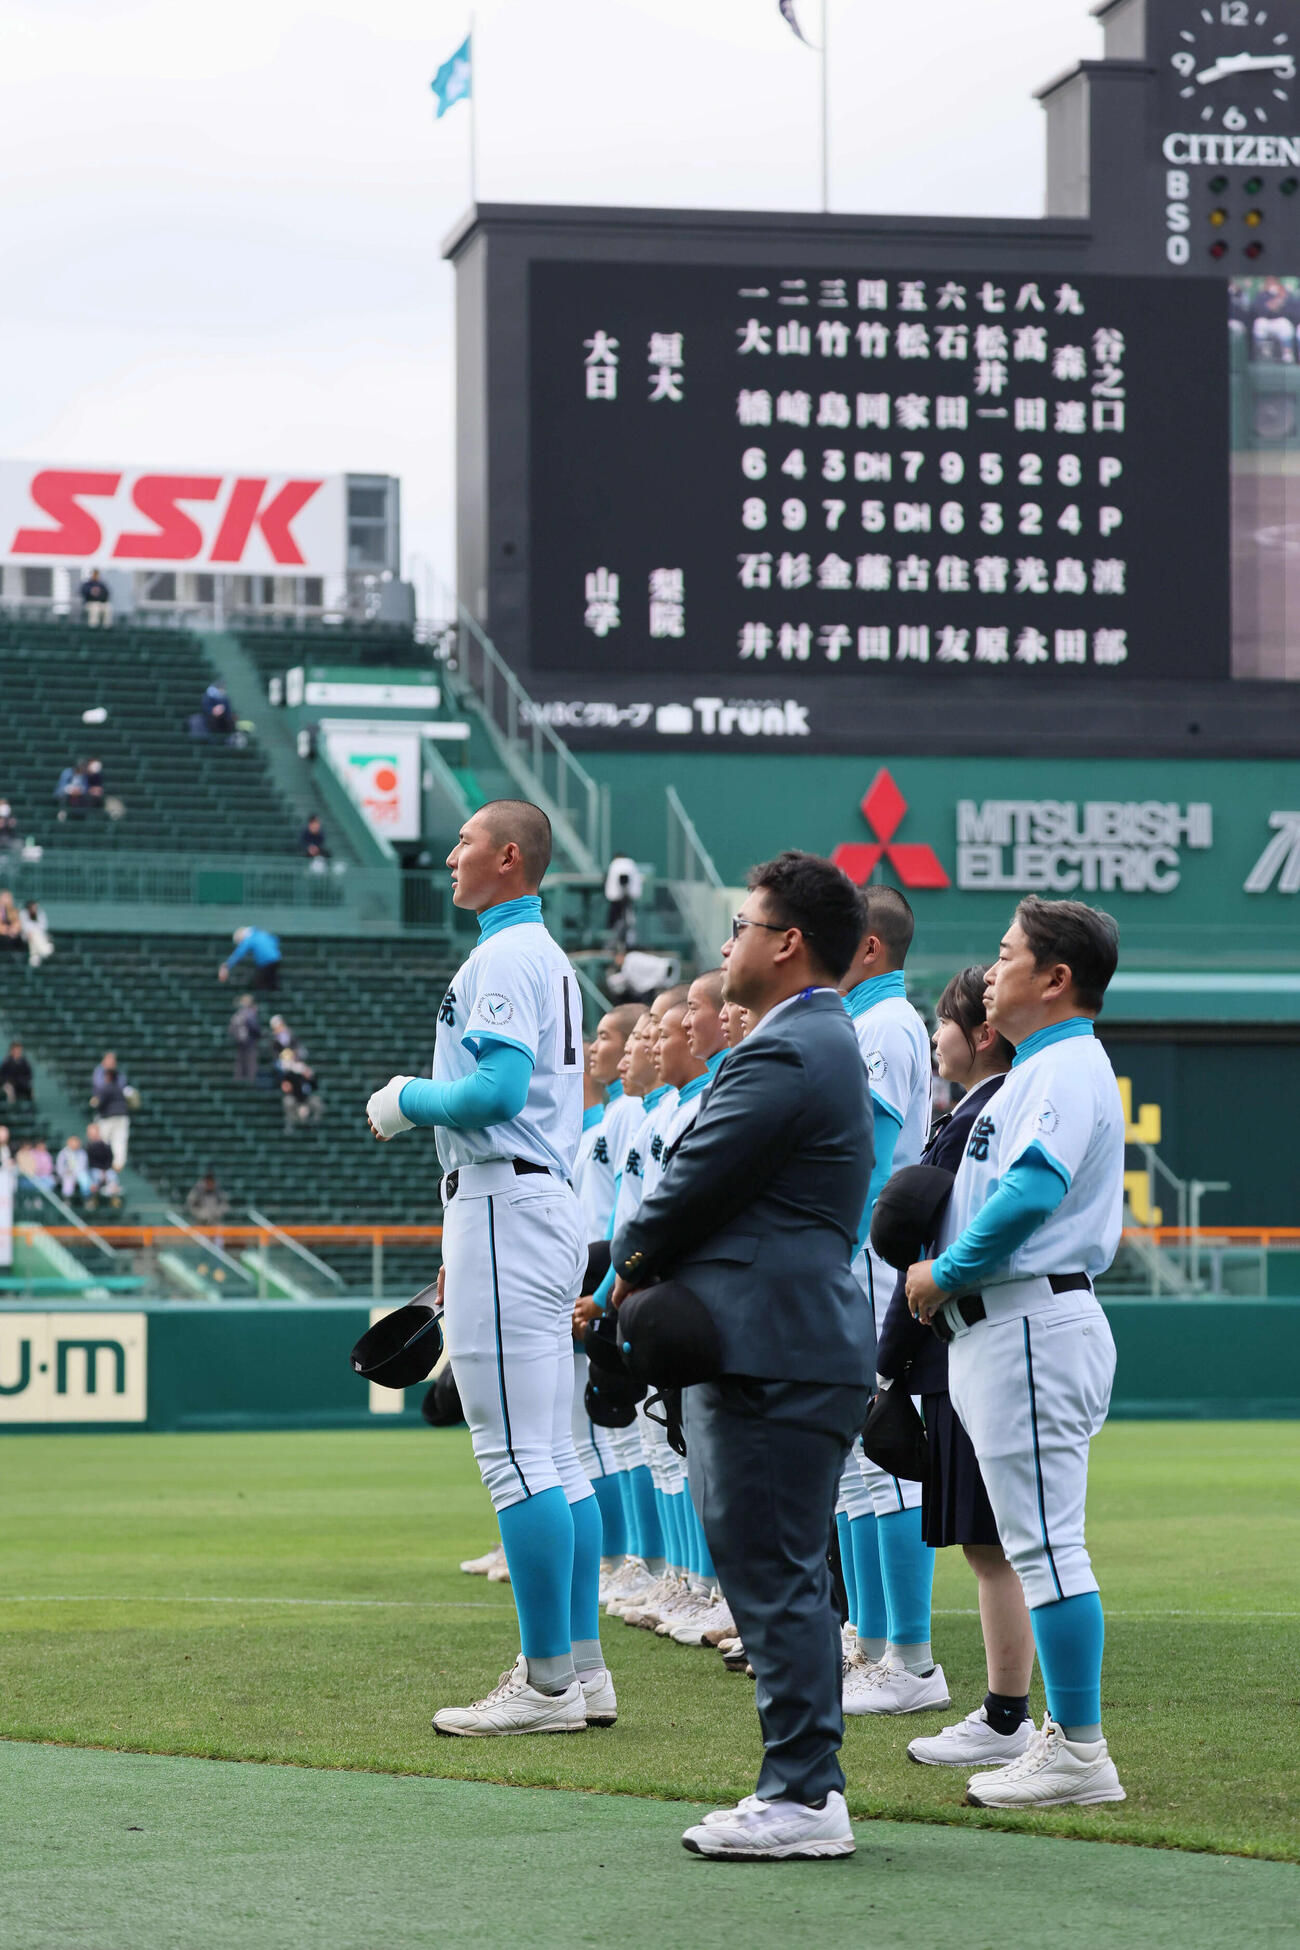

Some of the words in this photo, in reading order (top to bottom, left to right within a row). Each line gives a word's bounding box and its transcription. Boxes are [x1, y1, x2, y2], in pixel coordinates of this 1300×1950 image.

[1220, 1, 1250, 26] 12
[1171, 52, 1196, 77] 9
[1222, 106, 1247, 131] 6
[1166, 169, 1191, 201] B
[1166, 202, 1191, 233] S
[1166, 235, 1191, 266] O
[741, 447, 767, 480] 6
[781, 448, 807, 480] 4
[821, 449, 846, 482] 3
[854, 451, 892, 482] DH
[900, 450, 925, 482] 7
[939, 451, 965, 484] 9
[979, 452, 1004, 485] 5
[1018, 453, 1043, 485] 2
[1099, 456, 1123, 487] P
[10, 469, 325, 566] SSK
[742, 497, 767, 531] 8
[781, 498, 807, 531] 9
[822, 499, 846, 531] 7
[861, 499, 886, 533] 5
[894, 502, 932, 533] DH
[939, 501, 965, 534] 6
[979, 502, 1004, 535] 3
[1018, 502, 1043, 535] 2
[1057, 504, 1082, 535] 4
[1099, 506, 1123, 537] P
[693, 697, 810, 736] Trunk
[956, 799, 1213, 849] MITSUBISHI
[956, 847, 1181, 893] ELECTRIC
